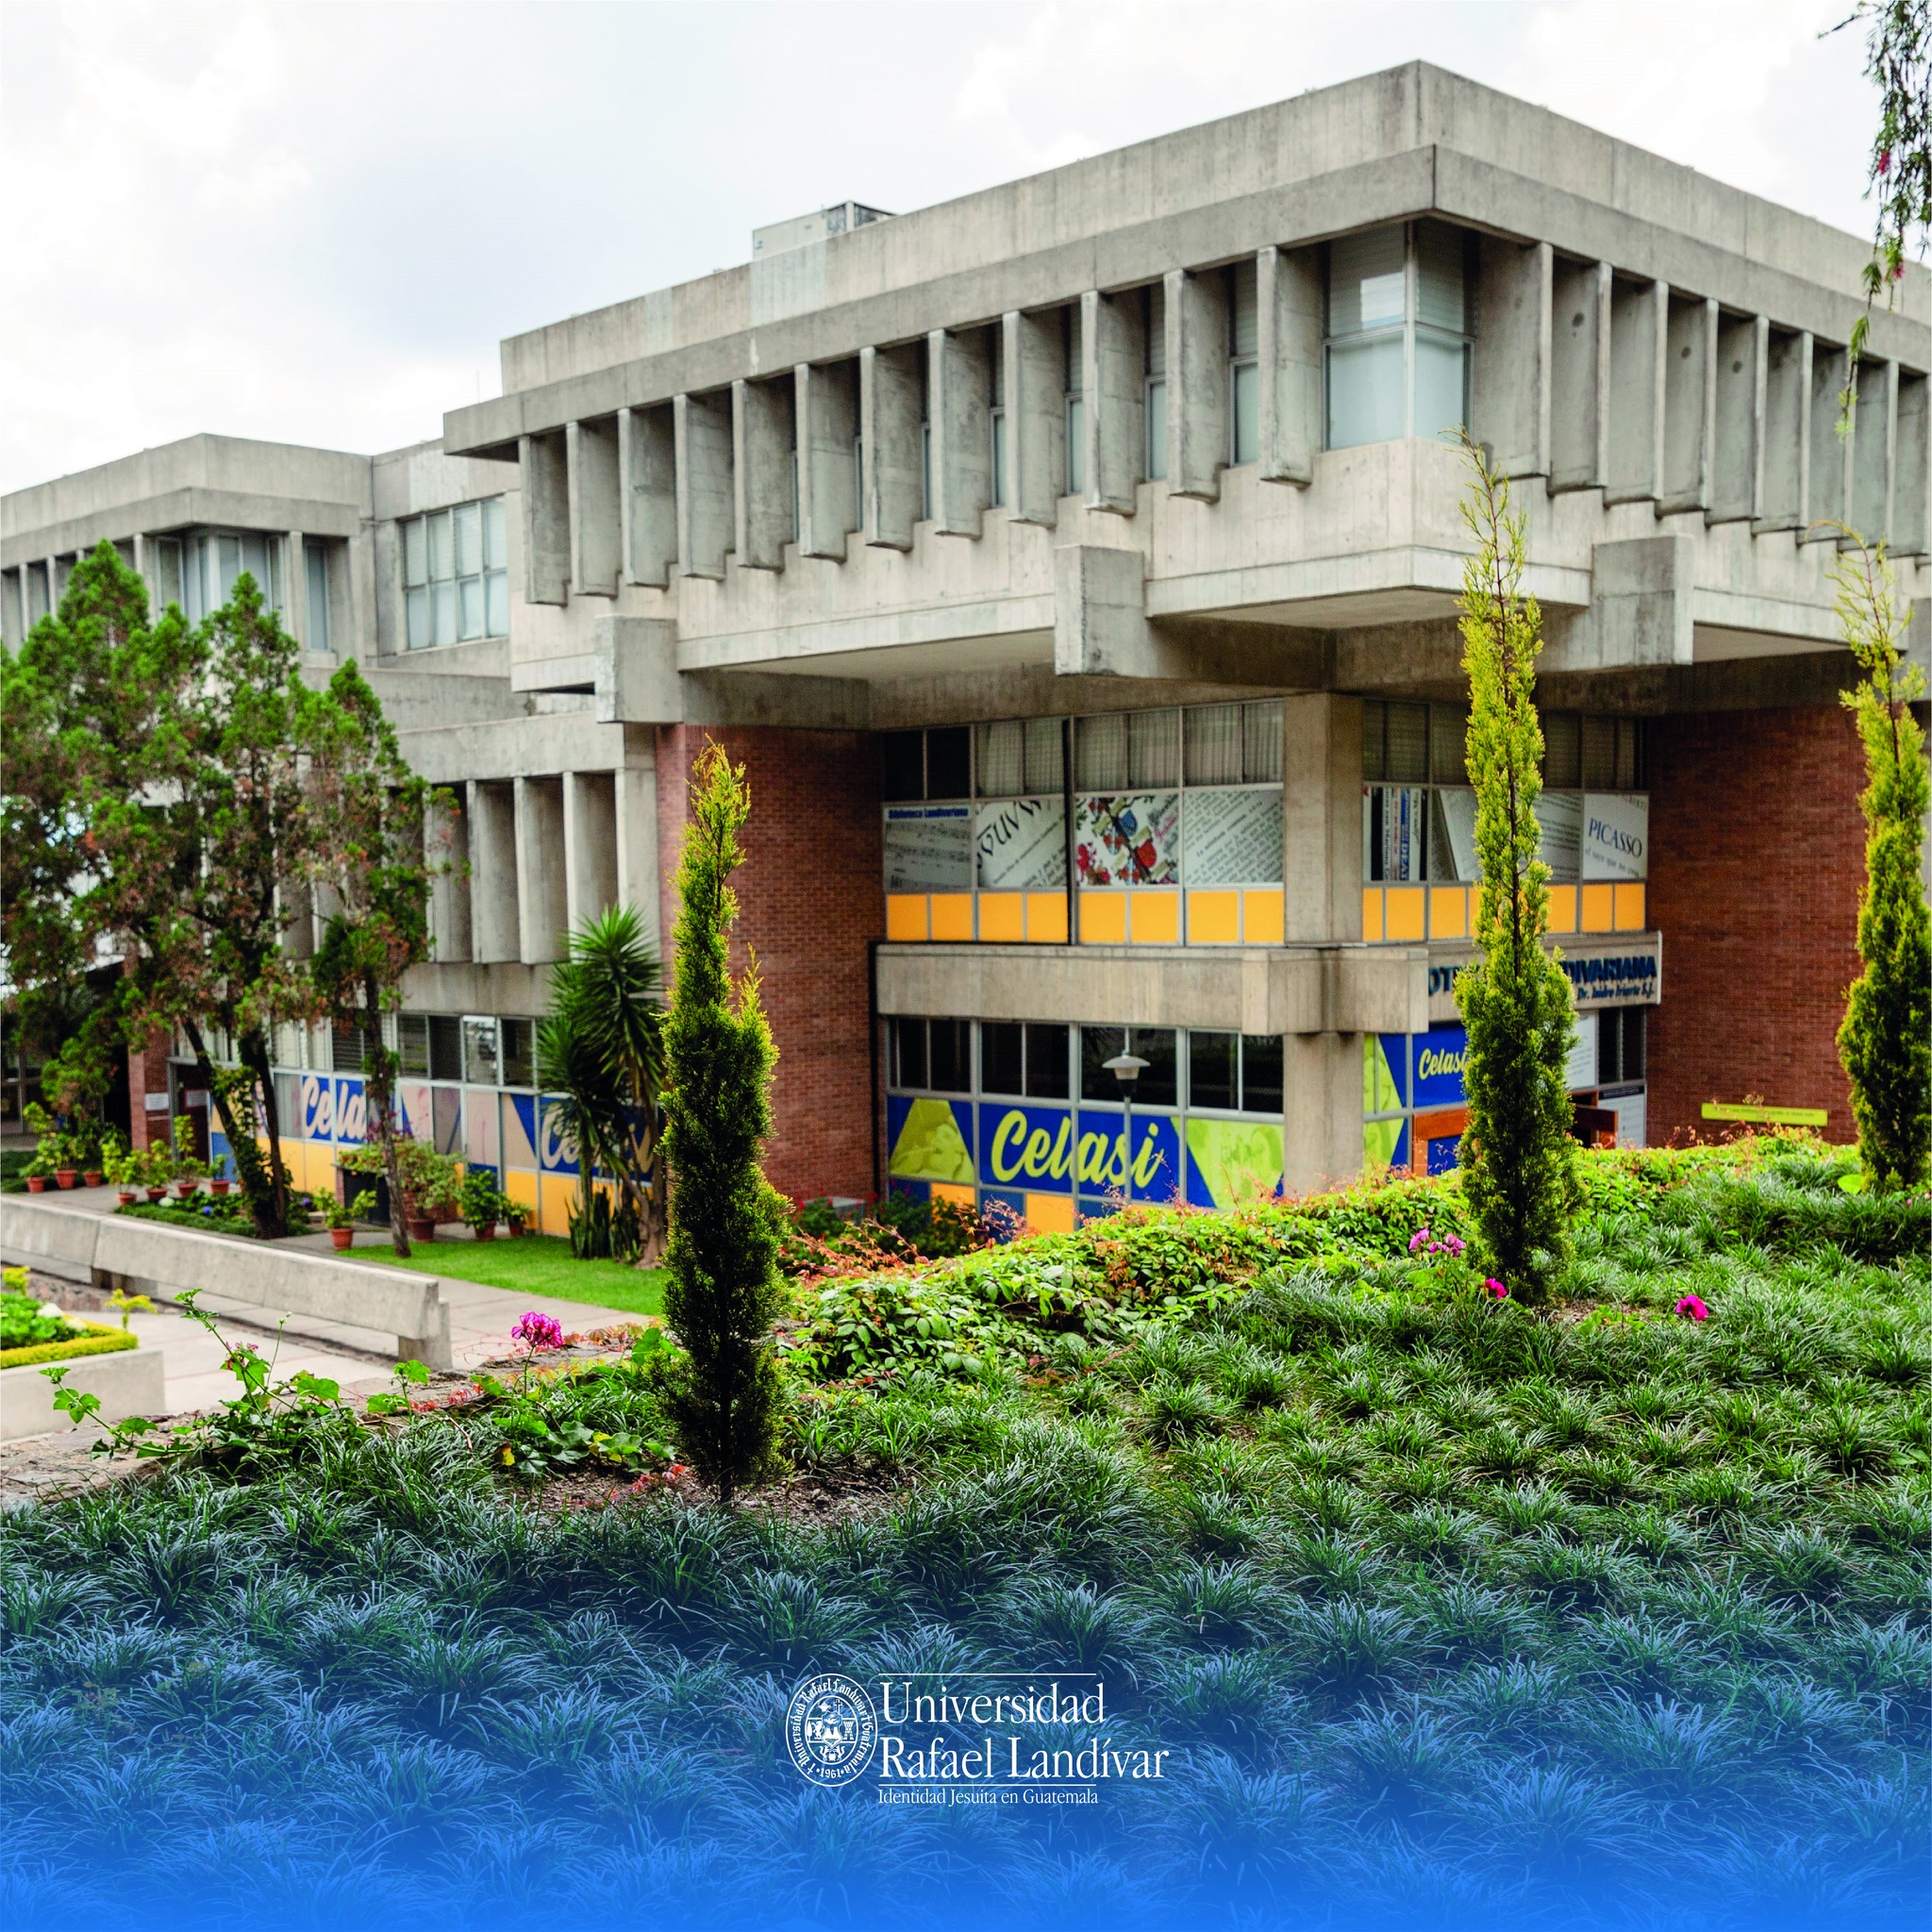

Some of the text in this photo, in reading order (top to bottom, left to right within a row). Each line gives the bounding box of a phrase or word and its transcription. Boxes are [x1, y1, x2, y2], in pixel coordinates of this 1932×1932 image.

[1589, 817, 1642, 859] PICASSO
[303, 1075, 367, 1140] Cela
[991, 1109, 1165, 1189] Celasi
